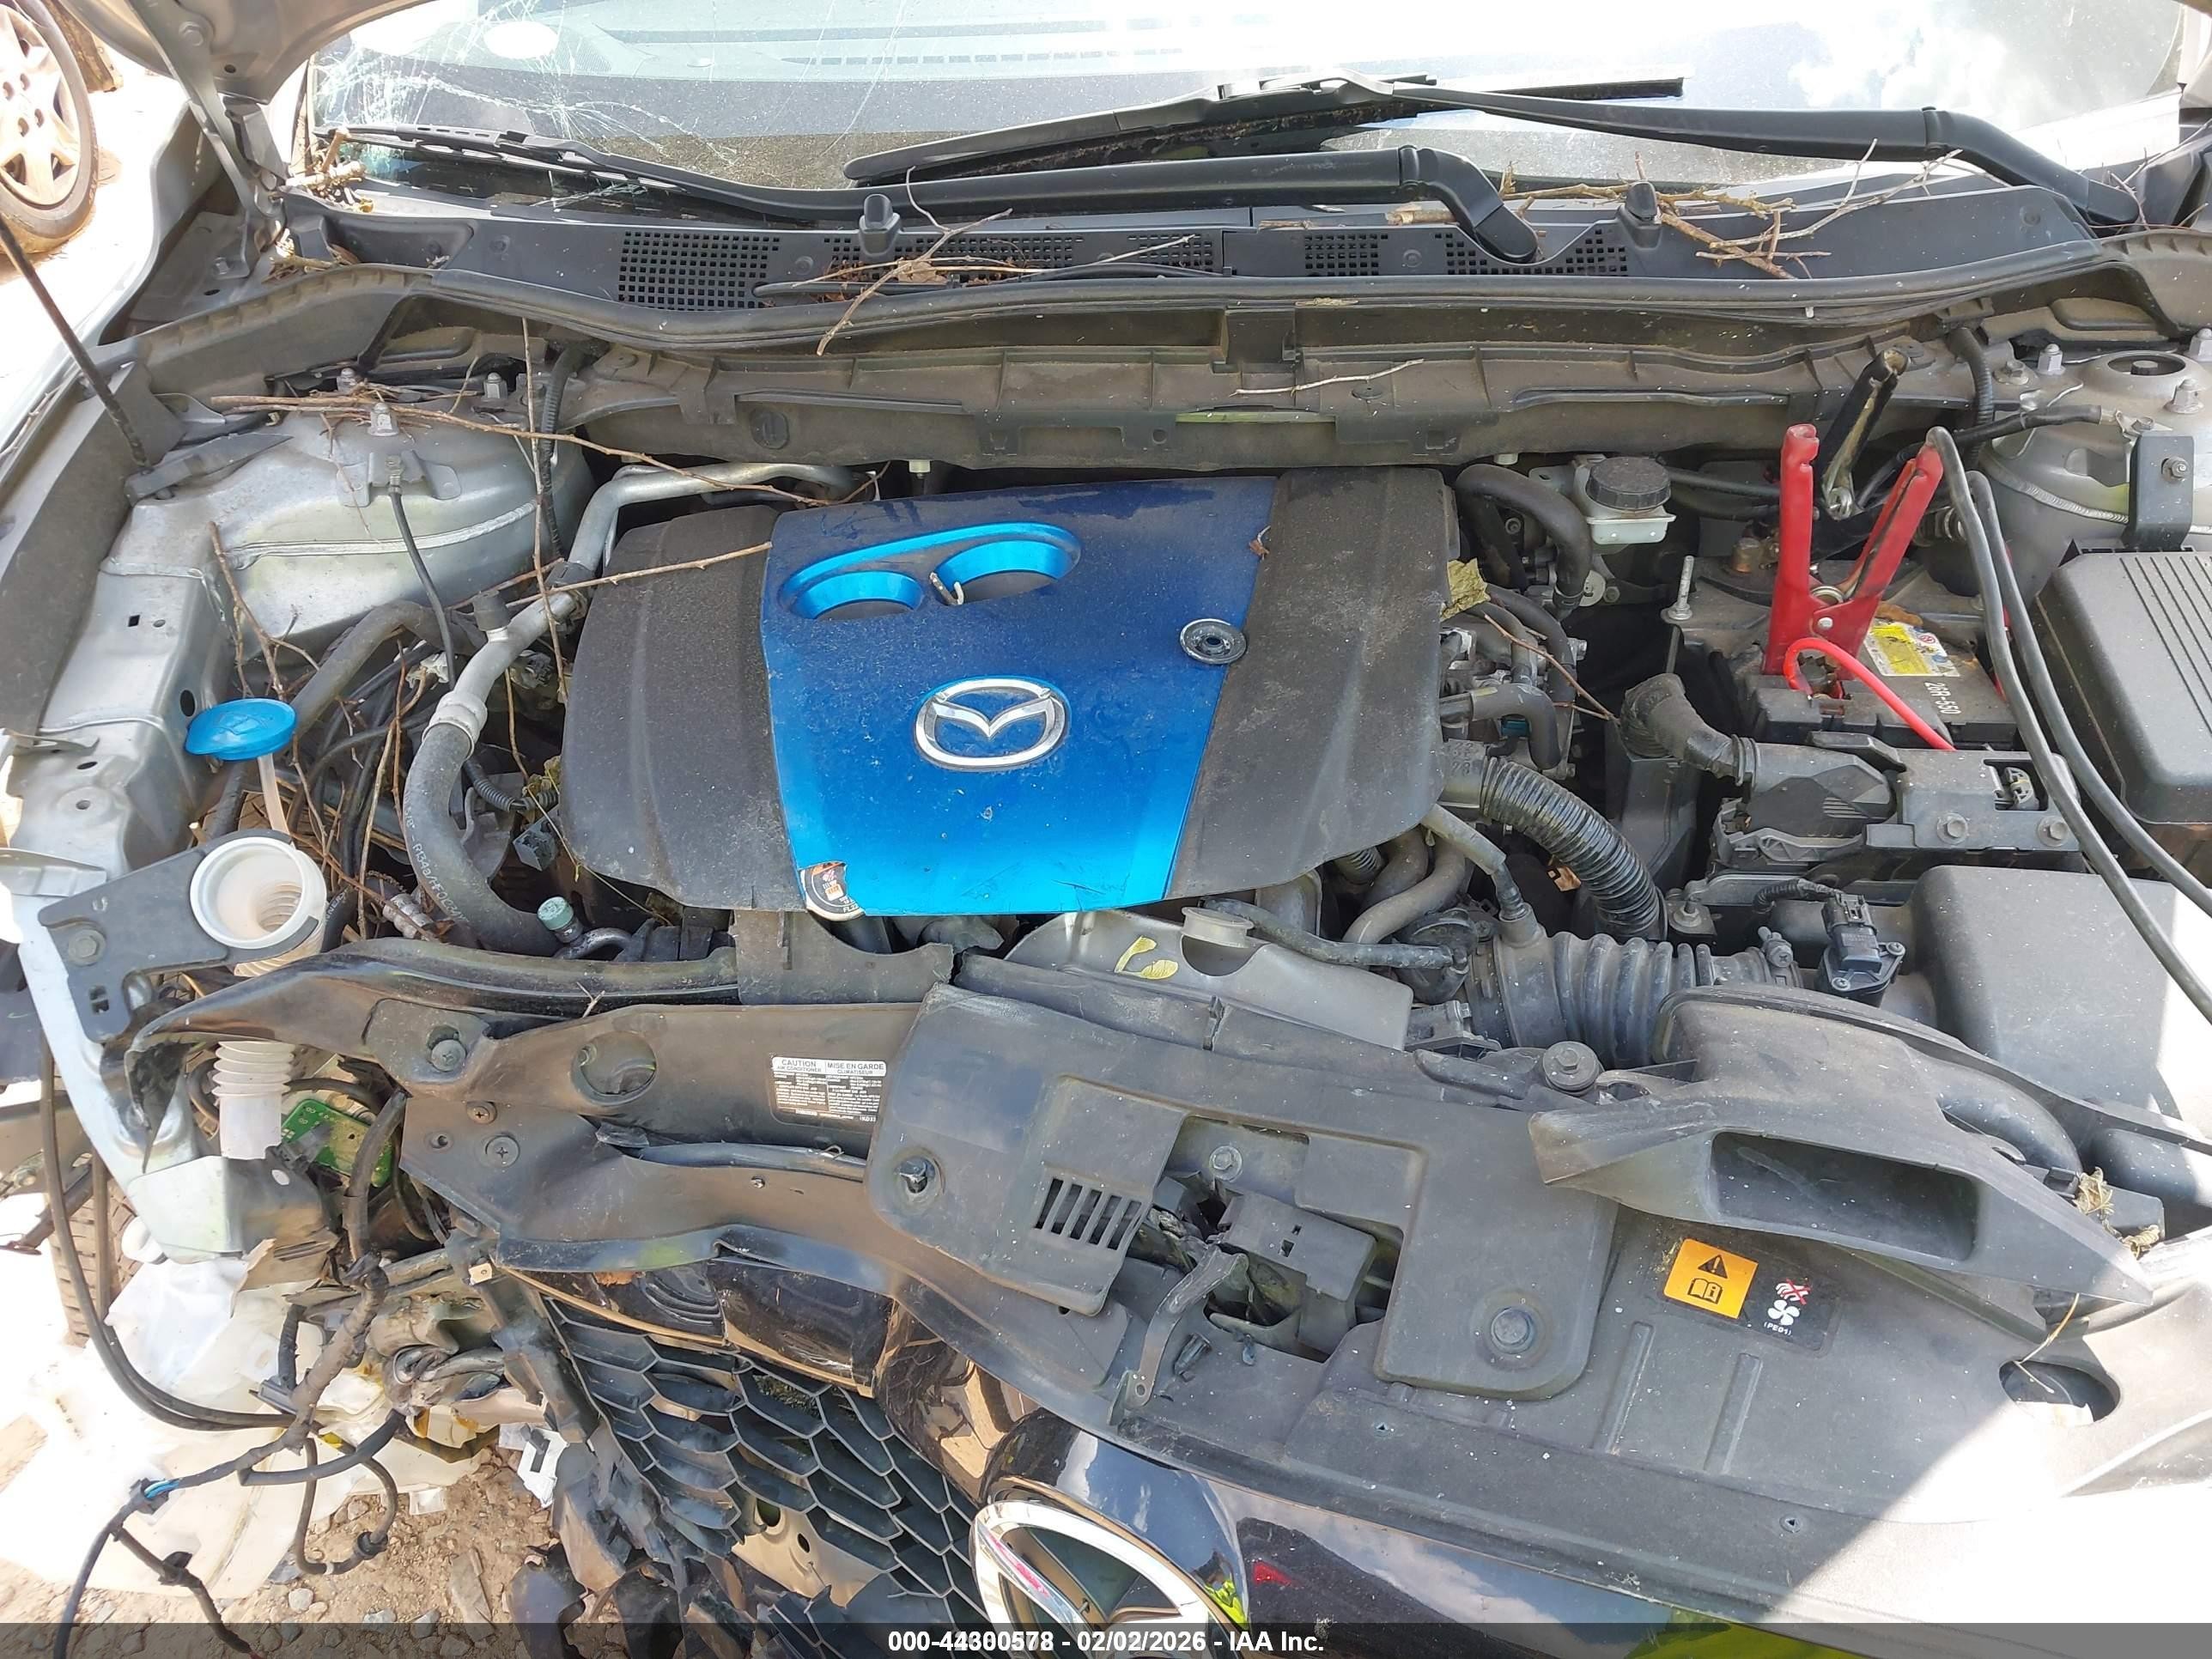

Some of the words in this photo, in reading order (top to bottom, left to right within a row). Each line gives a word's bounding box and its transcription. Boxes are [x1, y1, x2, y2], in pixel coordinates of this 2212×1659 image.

[1923, 682, 1962, 714] 26R-550
[781, 1059, 816, 1067] CAUTION
[1763, 1321, 1792, 1336] (PE01)
